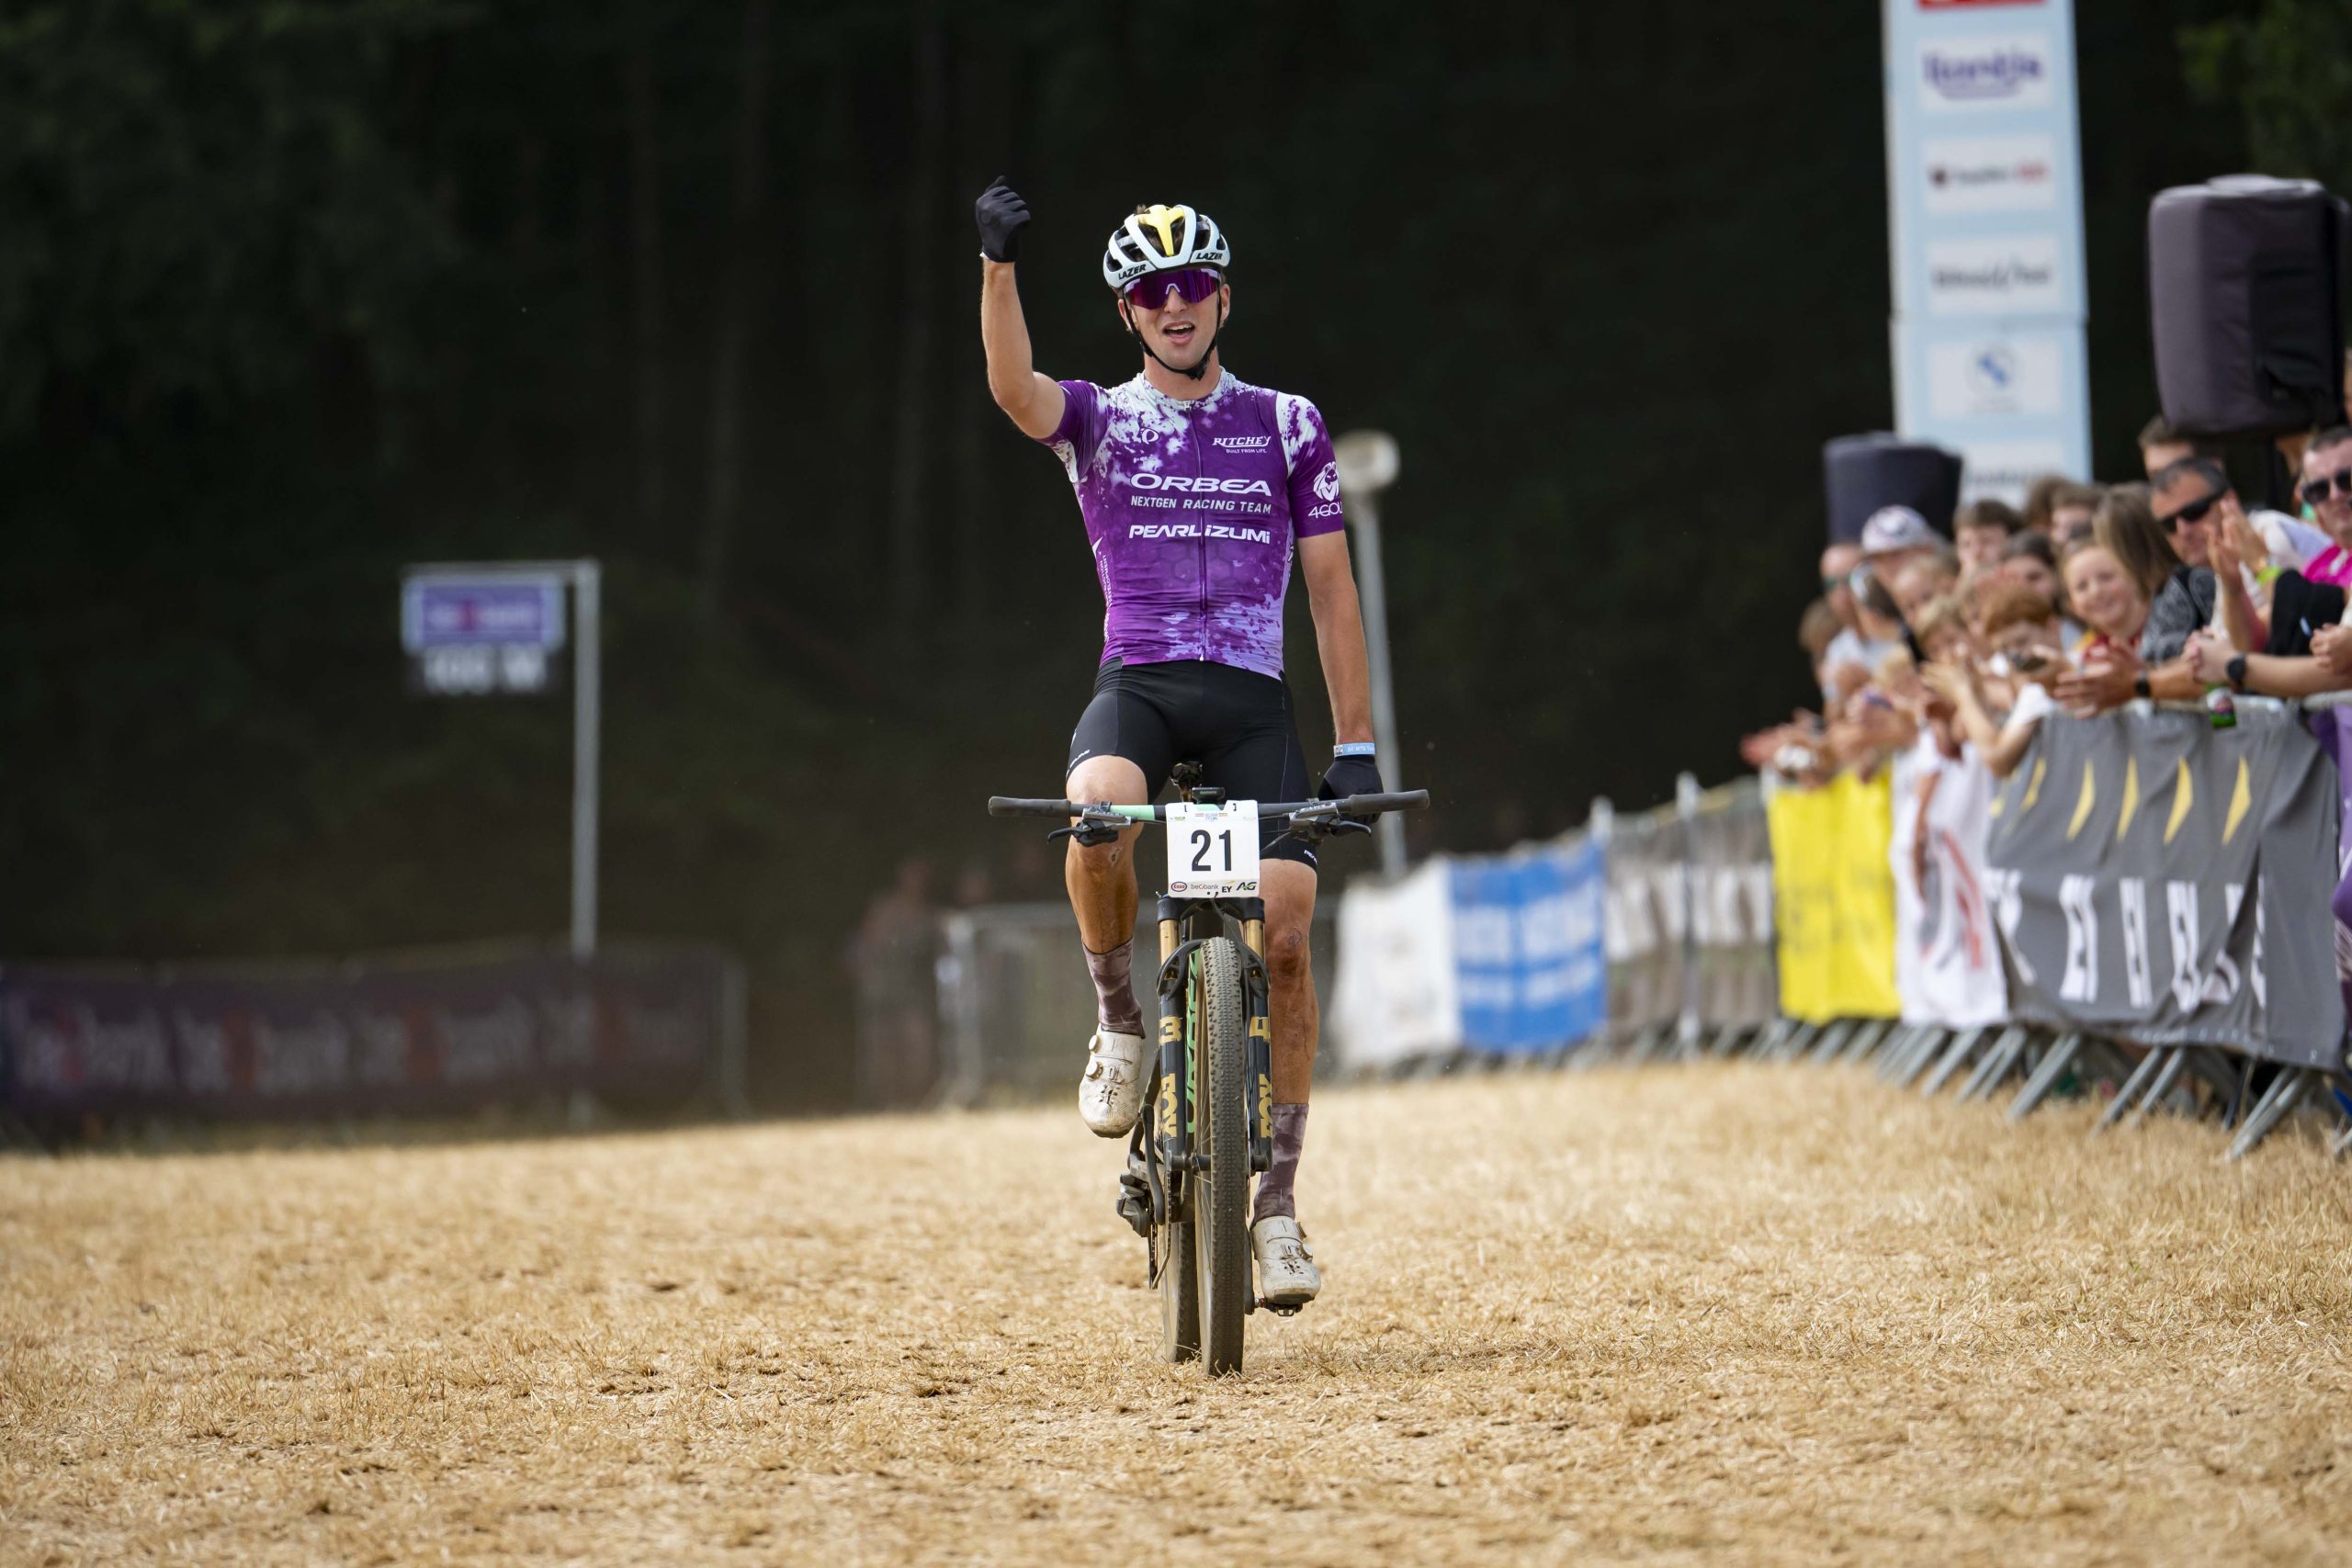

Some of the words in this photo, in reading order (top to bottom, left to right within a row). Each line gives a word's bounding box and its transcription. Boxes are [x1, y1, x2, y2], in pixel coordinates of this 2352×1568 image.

[1195, 252, 1223, 261] LAZER
[1118, 264, 1147, 280] LAZER
[1212, 435, 1272, 448] RITCHEY
[1130, 472, 1272, 497] ORBEA
[1130, 495, 1177, 509] NEXTGEN
[1182, 499, 1235, 511] RACING
[1239, 501, 1272, 514] TEAM
[1191, 829, 1232, 872] 21
[1161, 1073, 1178, 1138] FOX
